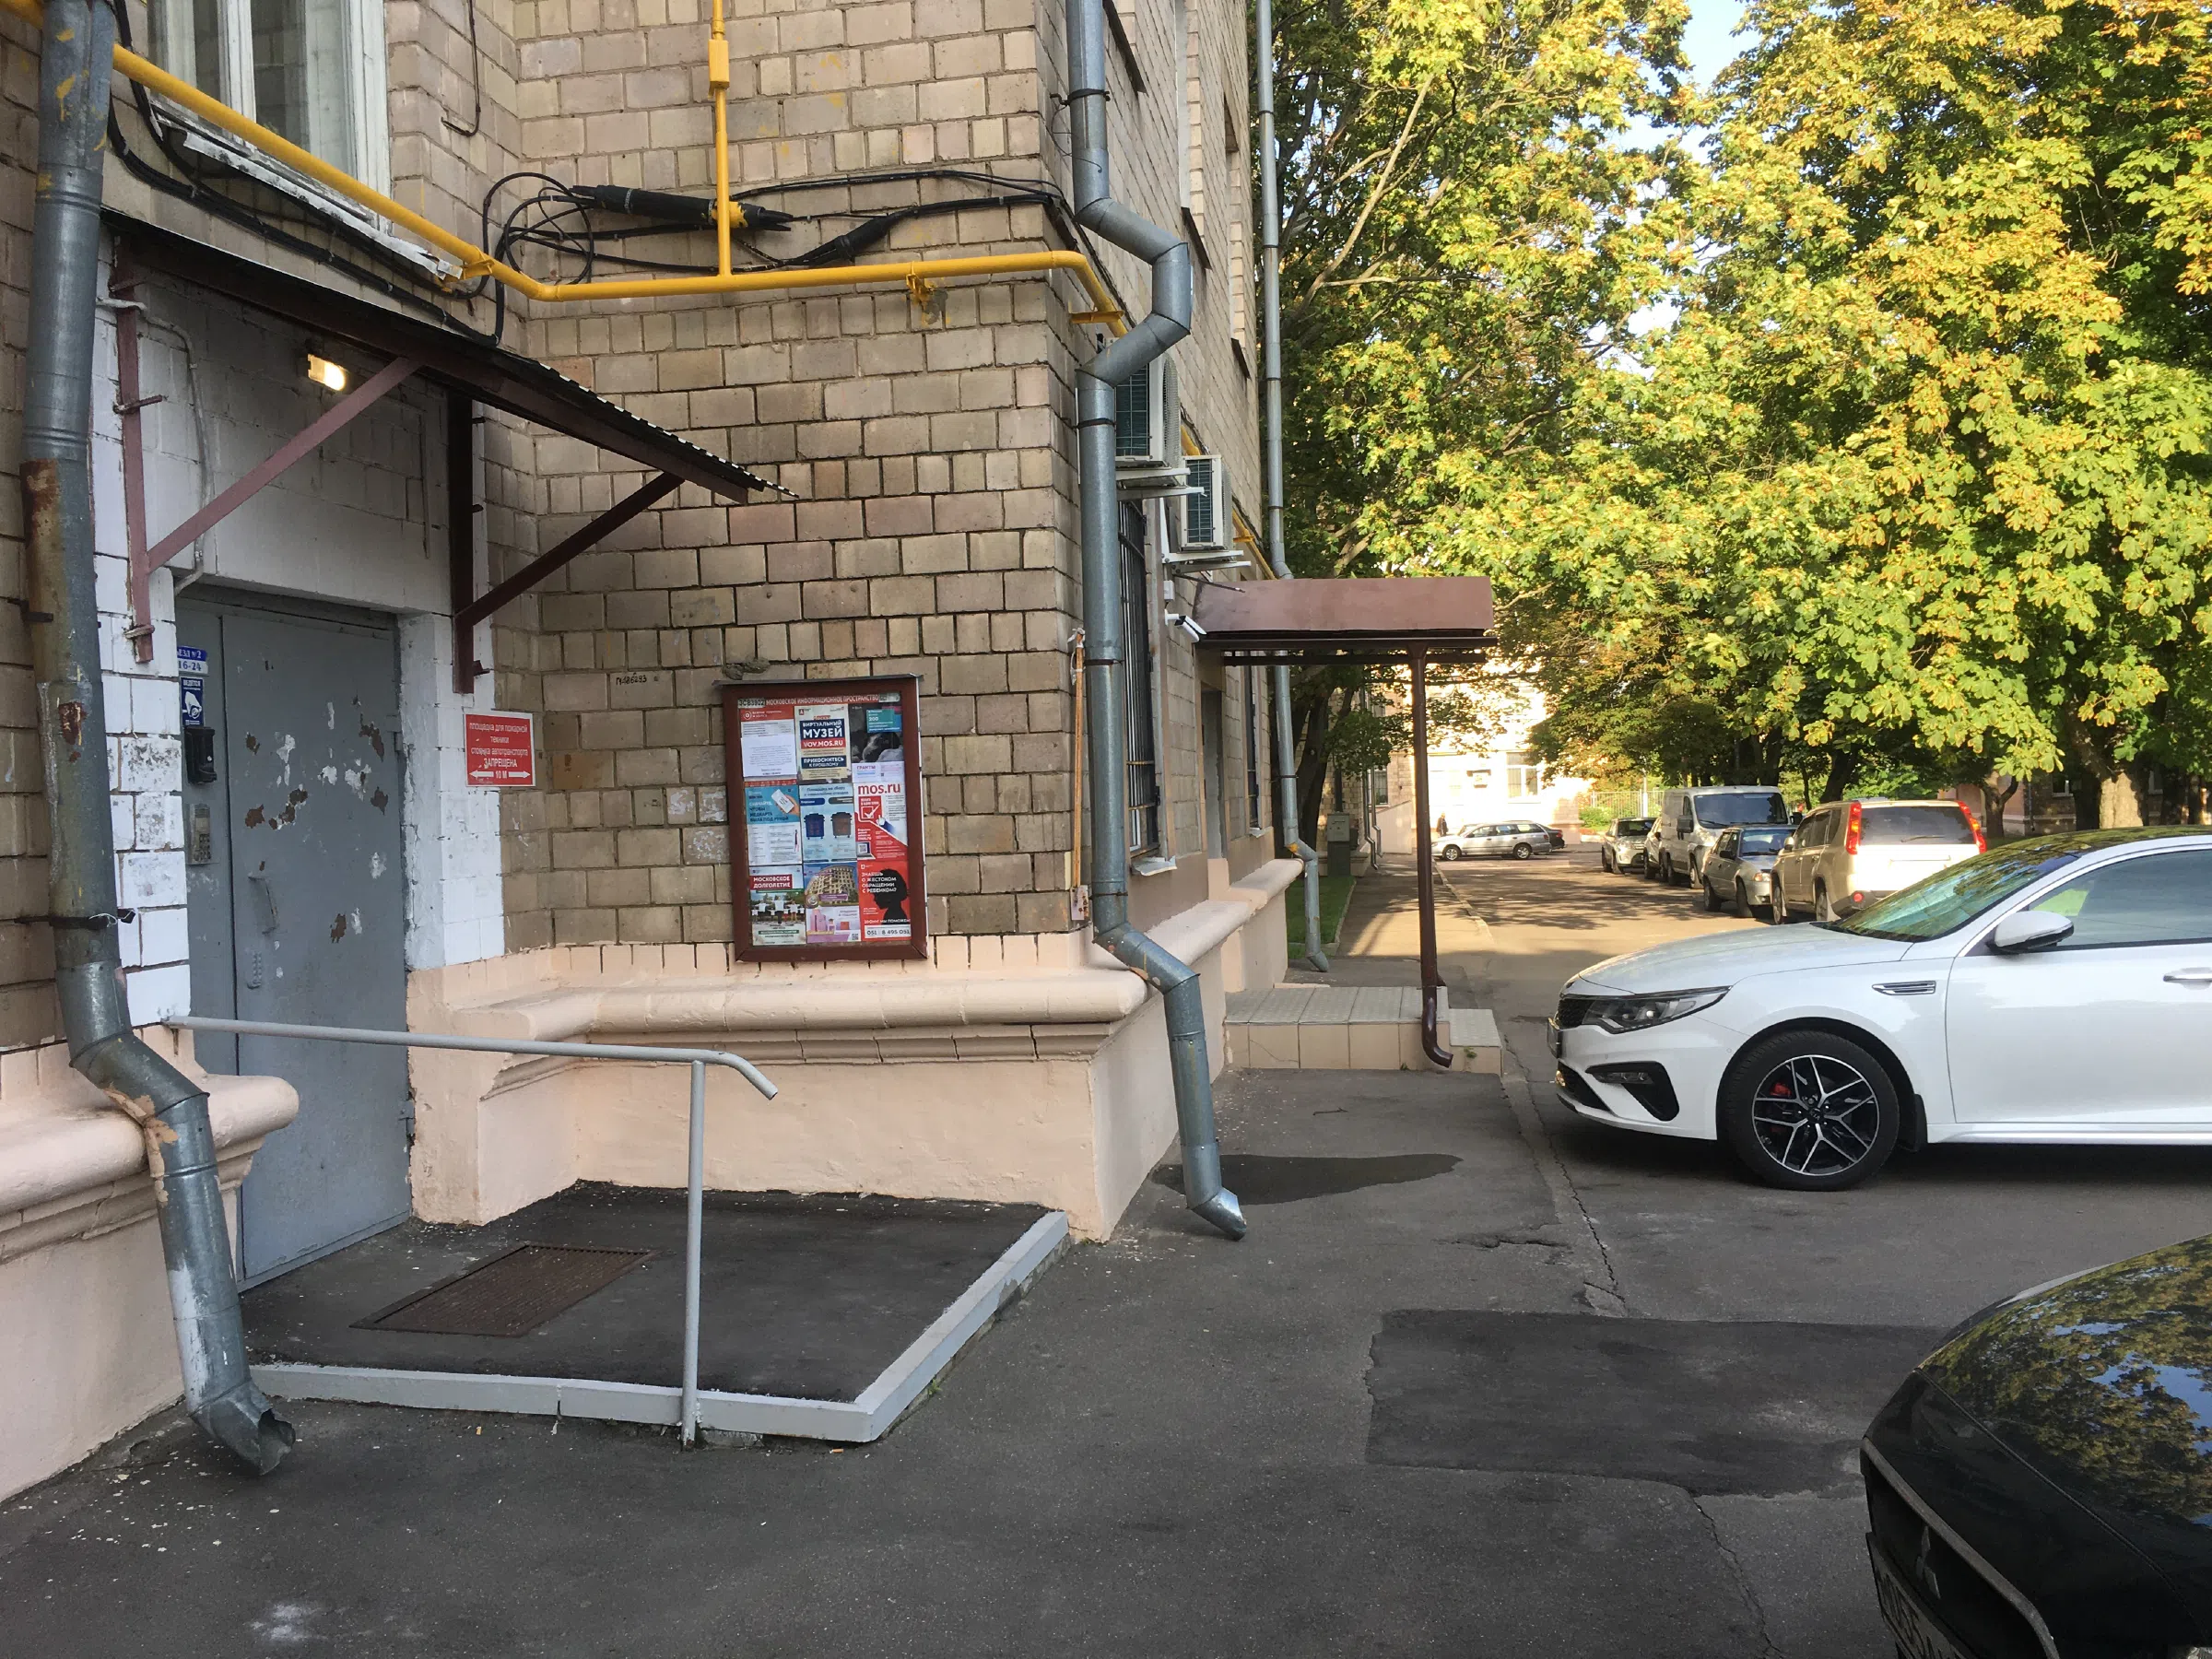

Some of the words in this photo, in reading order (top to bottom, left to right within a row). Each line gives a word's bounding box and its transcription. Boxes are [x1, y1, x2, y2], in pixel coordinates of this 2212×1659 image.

[179, 661, 202, 671] 16-24
[766, 698, 796, 706] МОСКОВСКОЕ
[797, 696, 842, 704] ИНФОРМАЦИОННОЕ
[843, 694, 878, 702] ПРОСТРАНСТВО
[803, 725, 842, 738] МУЗЕЙ
[484, 758, 517, 768] ЗАПРЕЩЕНА
[858, 783, 900, 795] mos.ru
